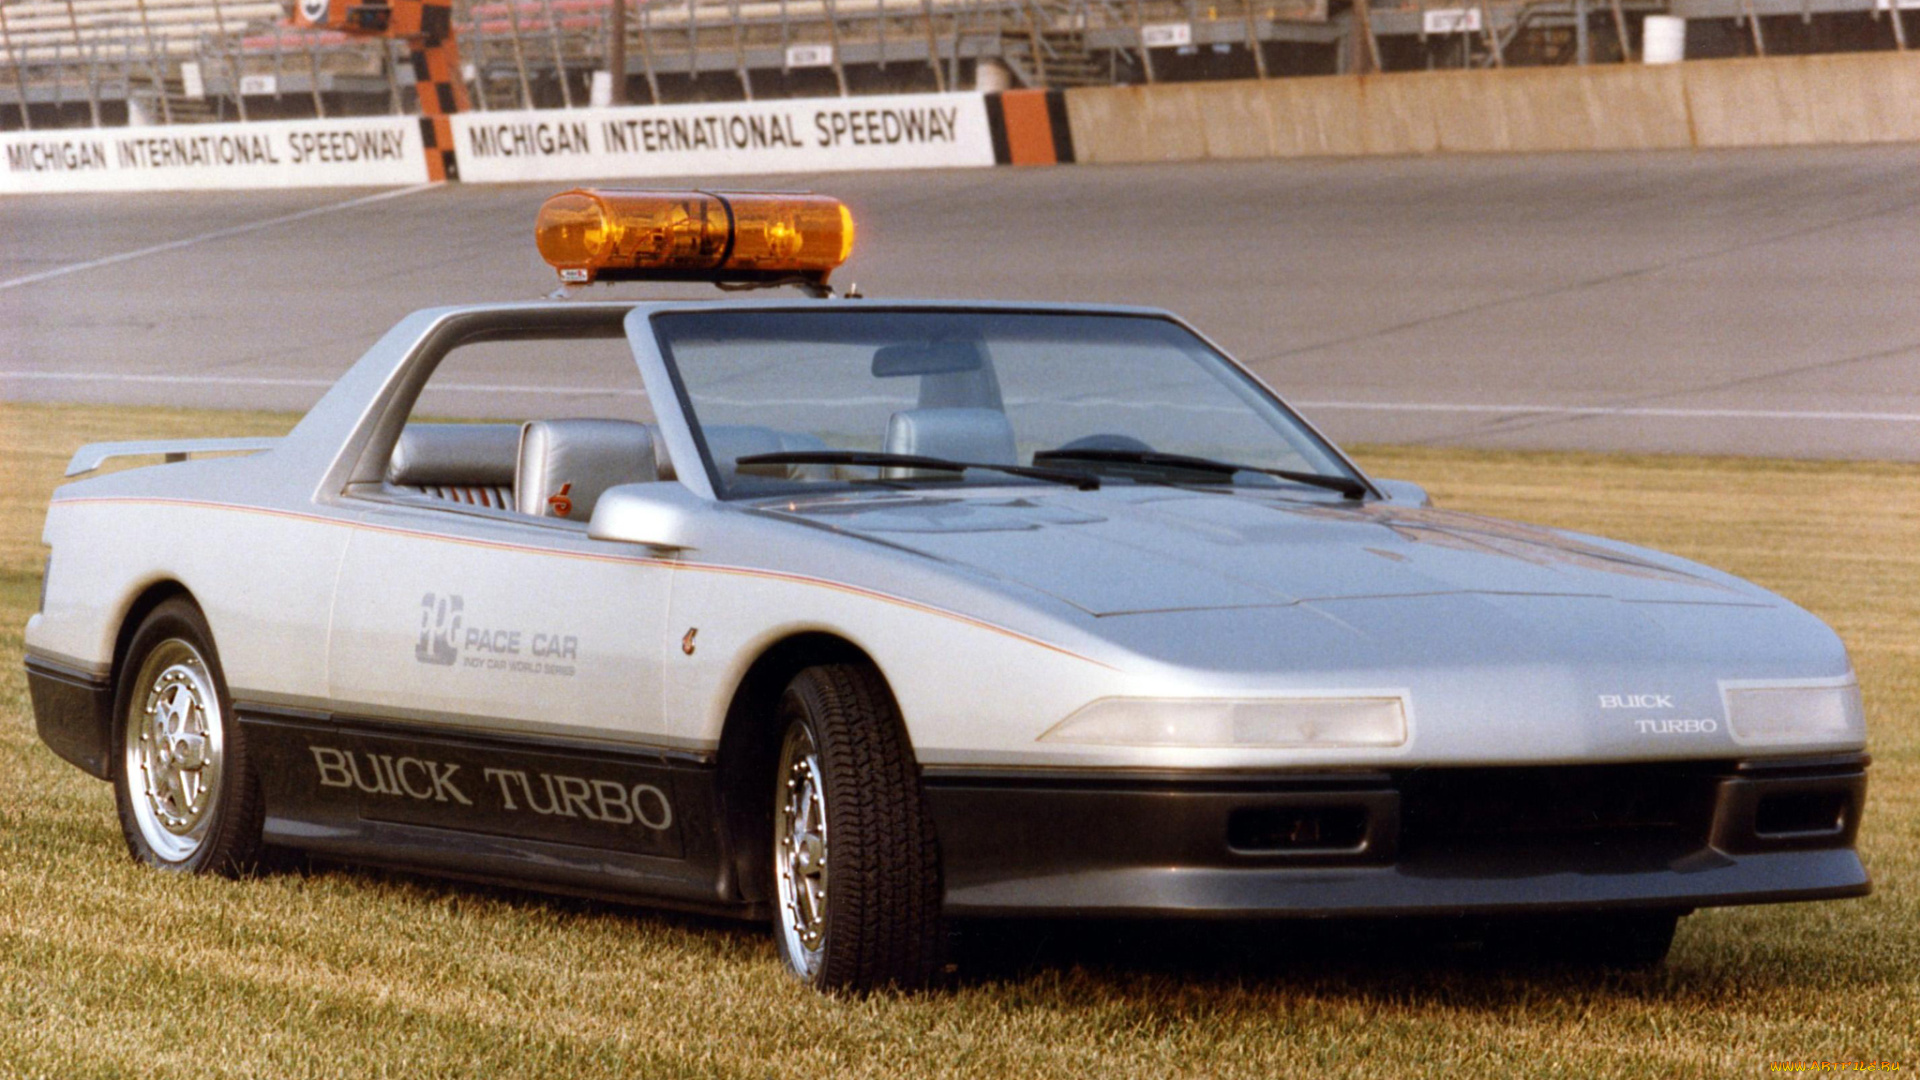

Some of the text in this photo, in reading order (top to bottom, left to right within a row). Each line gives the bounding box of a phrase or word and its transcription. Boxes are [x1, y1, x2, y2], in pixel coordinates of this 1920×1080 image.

[469, 107, 958, 157] MICHIGAN INTERNATIONAL SPEEDWAY
[7, 130, 404, 172] MICHIGAN INTERNATIONAL SPEEDWAY
[465, 627, 578, 659] PACE CAR
[487, 659, 507, 670] CAR
[509, 661, 542, 674] WORLD
[1598, 694, 1674, 709] BUICK
[1635, 719, 1718, 734] TURBO
[309, 746, 673, 831] BUICK TURBO
